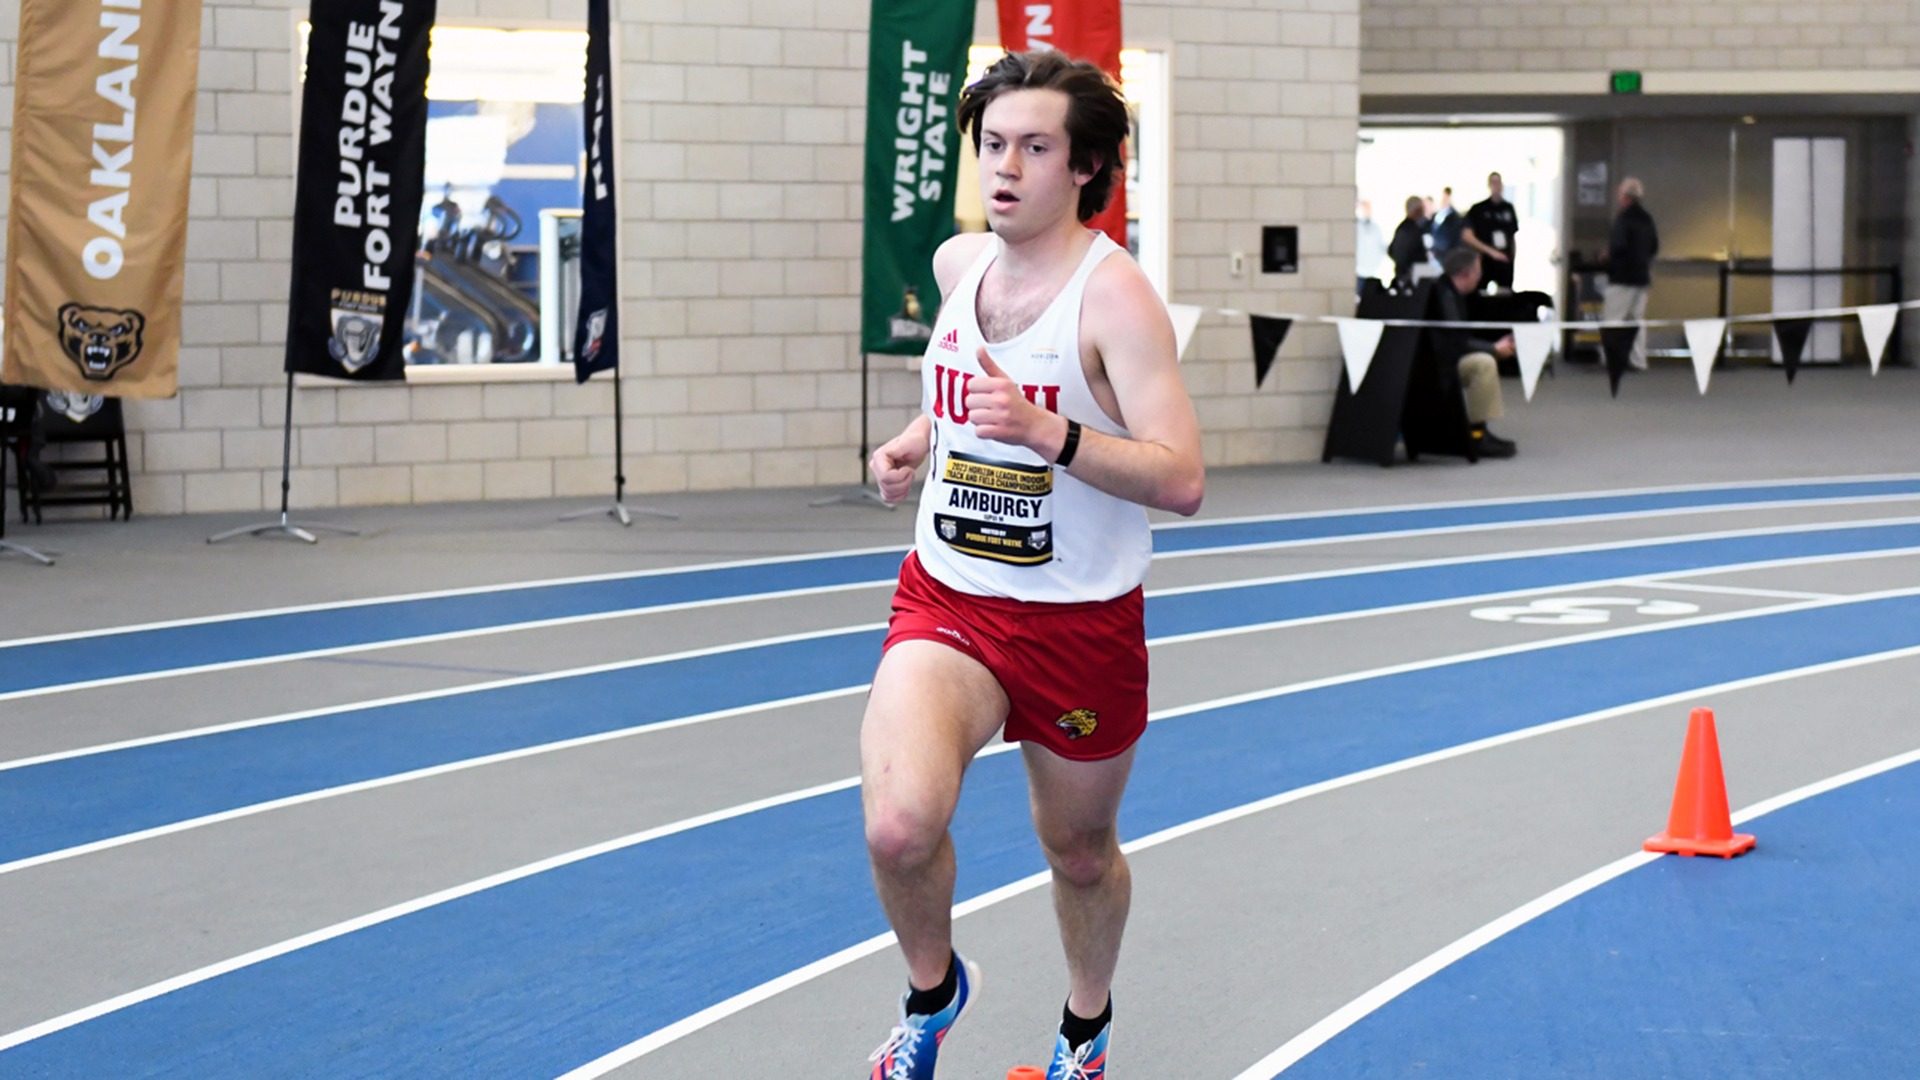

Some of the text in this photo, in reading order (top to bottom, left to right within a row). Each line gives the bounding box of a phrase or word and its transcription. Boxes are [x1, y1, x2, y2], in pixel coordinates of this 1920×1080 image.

[82, 0, 142, 279] OAKLAN
[334, 21, 375, 227] PURDUE
[891, 40, 928, 222] WRIGHT
[919, 71, 950, 202] STATE
[364, 164, 391, 291] FORT
[948, 487, 1043, 518] AMBURGY
